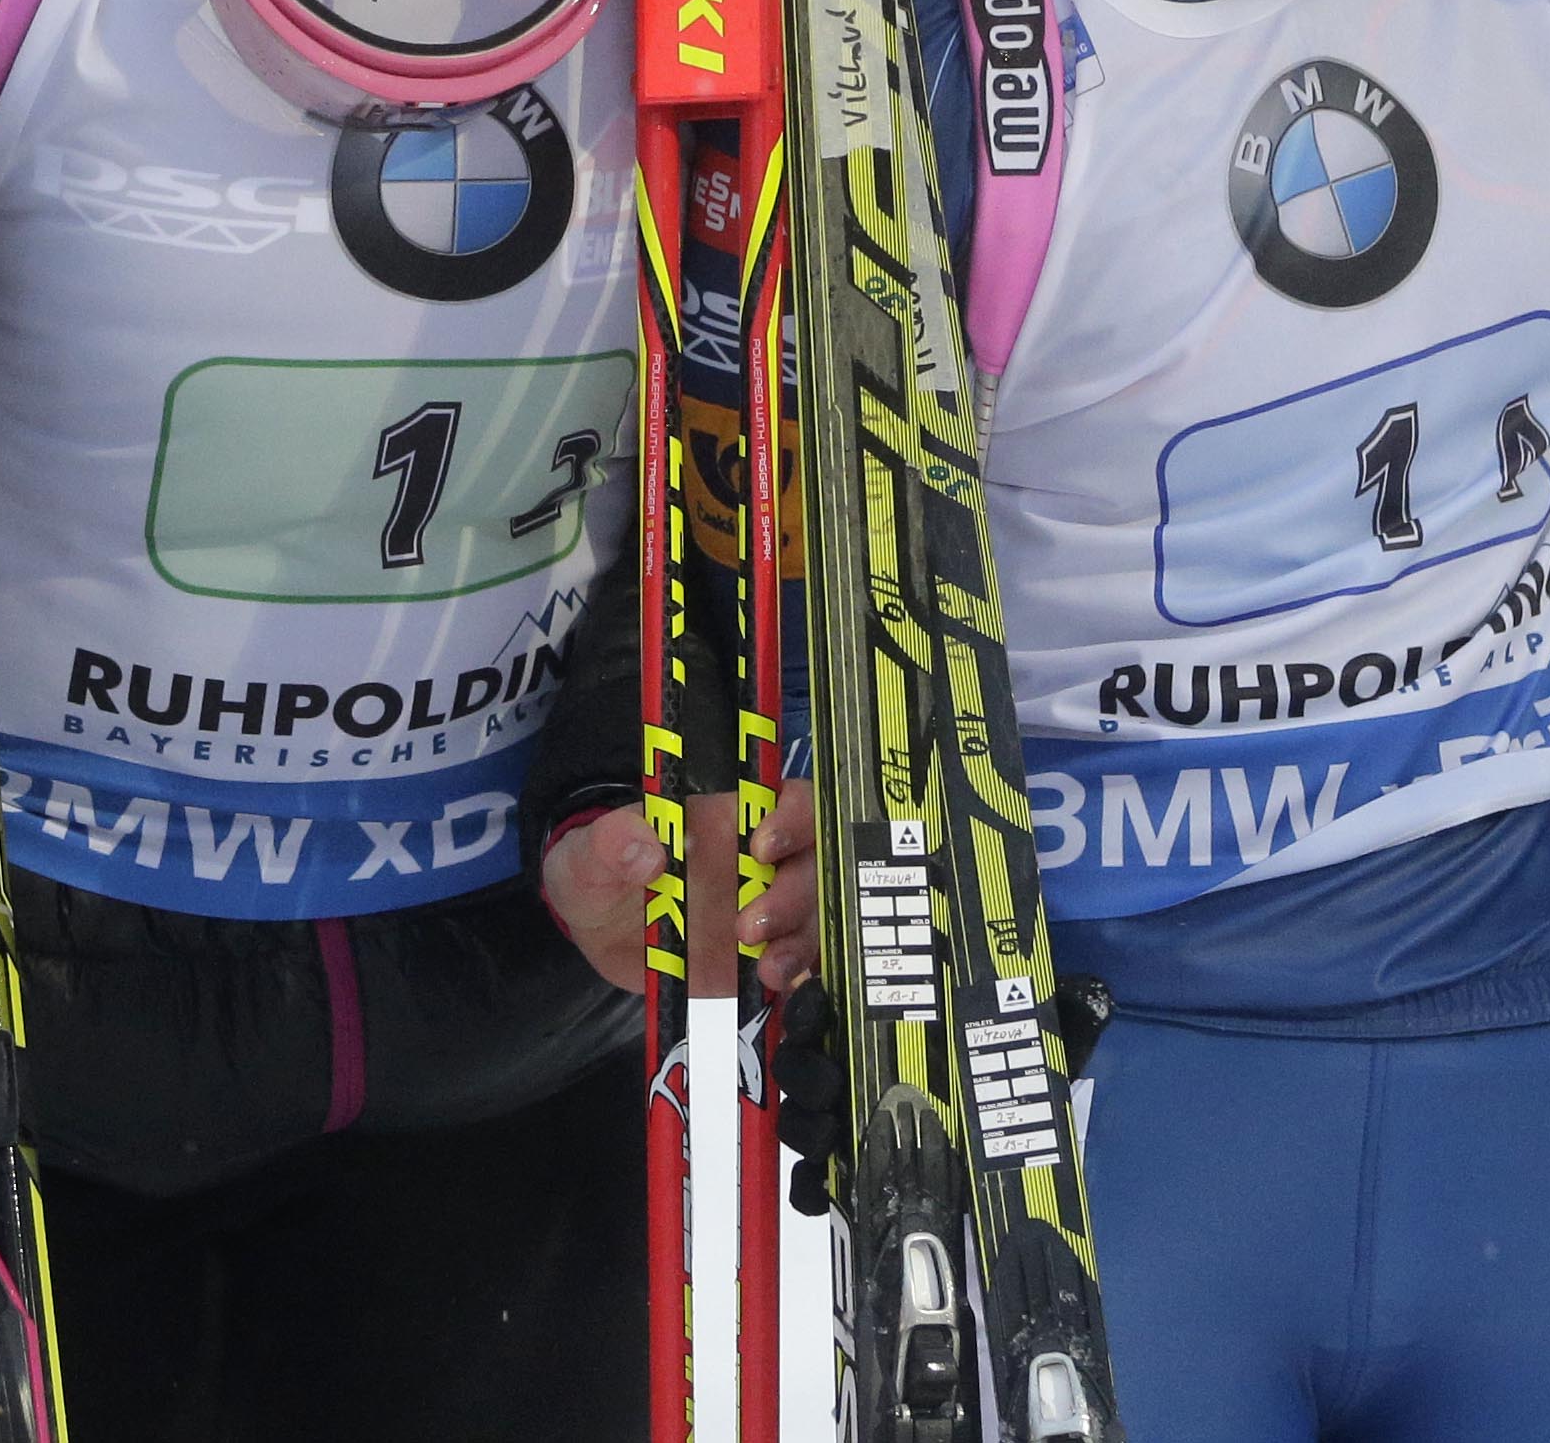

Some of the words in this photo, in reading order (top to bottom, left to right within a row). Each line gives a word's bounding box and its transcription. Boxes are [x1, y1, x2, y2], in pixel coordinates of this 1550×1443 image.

[1235, 65, 1397, 176] BMW
[651, 353, 662, 424] POWERED
[753, 337, 764, 403] POWERED
[649, 426, 660, 456] WITH
[755, 406, 766, 441] WITH
[371, 401, 462, 571] 1
[647, 459, 658, 515] TRIGGER
[757, 443, 770, 501] TRIGGER
[1354, 401, 1424, 552] 1
[761, 515, 772, 562] SHARK
[65, 643, 579, 741] RUHPOLDIN
[63, 712, 448, 769] BAYERISCHE
[642, 723, 685, 983] LEKI
